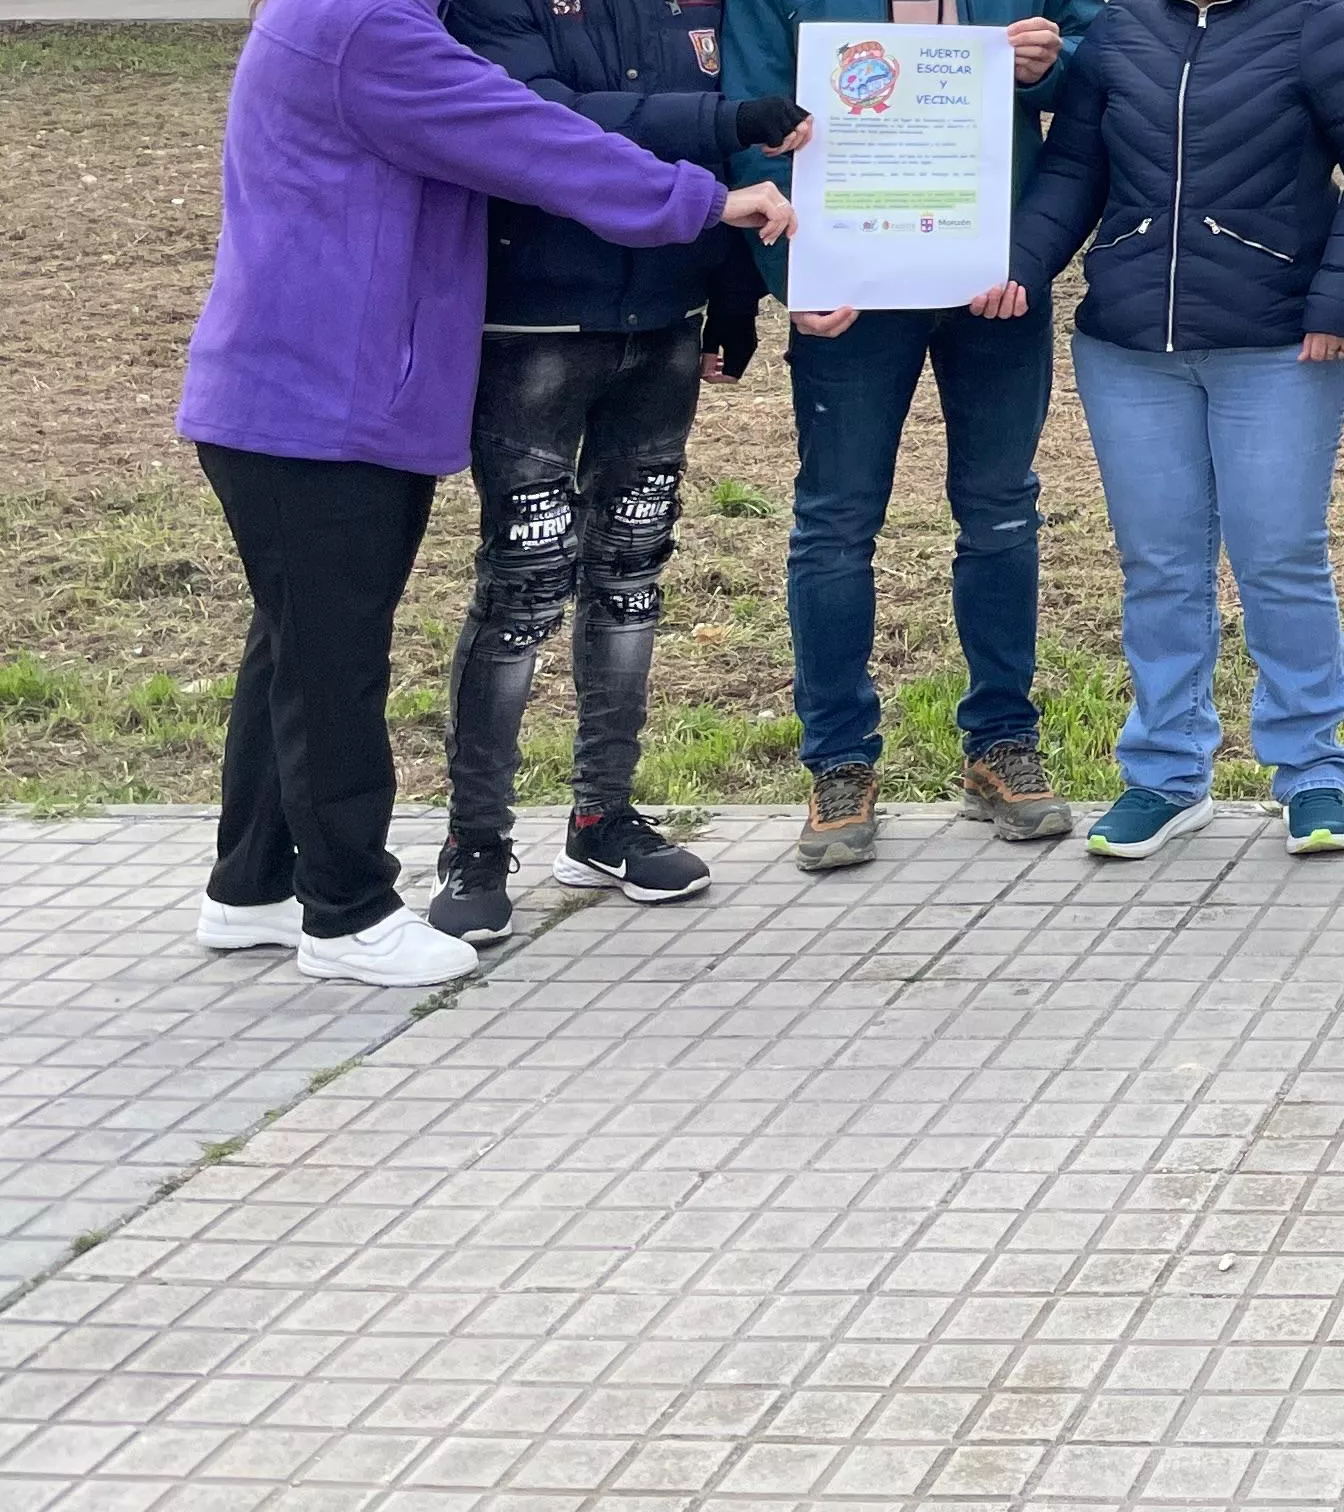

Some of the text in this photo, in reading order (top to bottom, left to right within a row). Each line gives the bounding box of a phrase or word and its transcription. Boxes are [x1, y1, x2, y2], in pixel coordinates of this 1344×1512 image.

[920, 48, 970, 59] HUERTO
[917, 63, 972, 74] ESCOLAR
[916, 94, 970, 105] VECINAL
